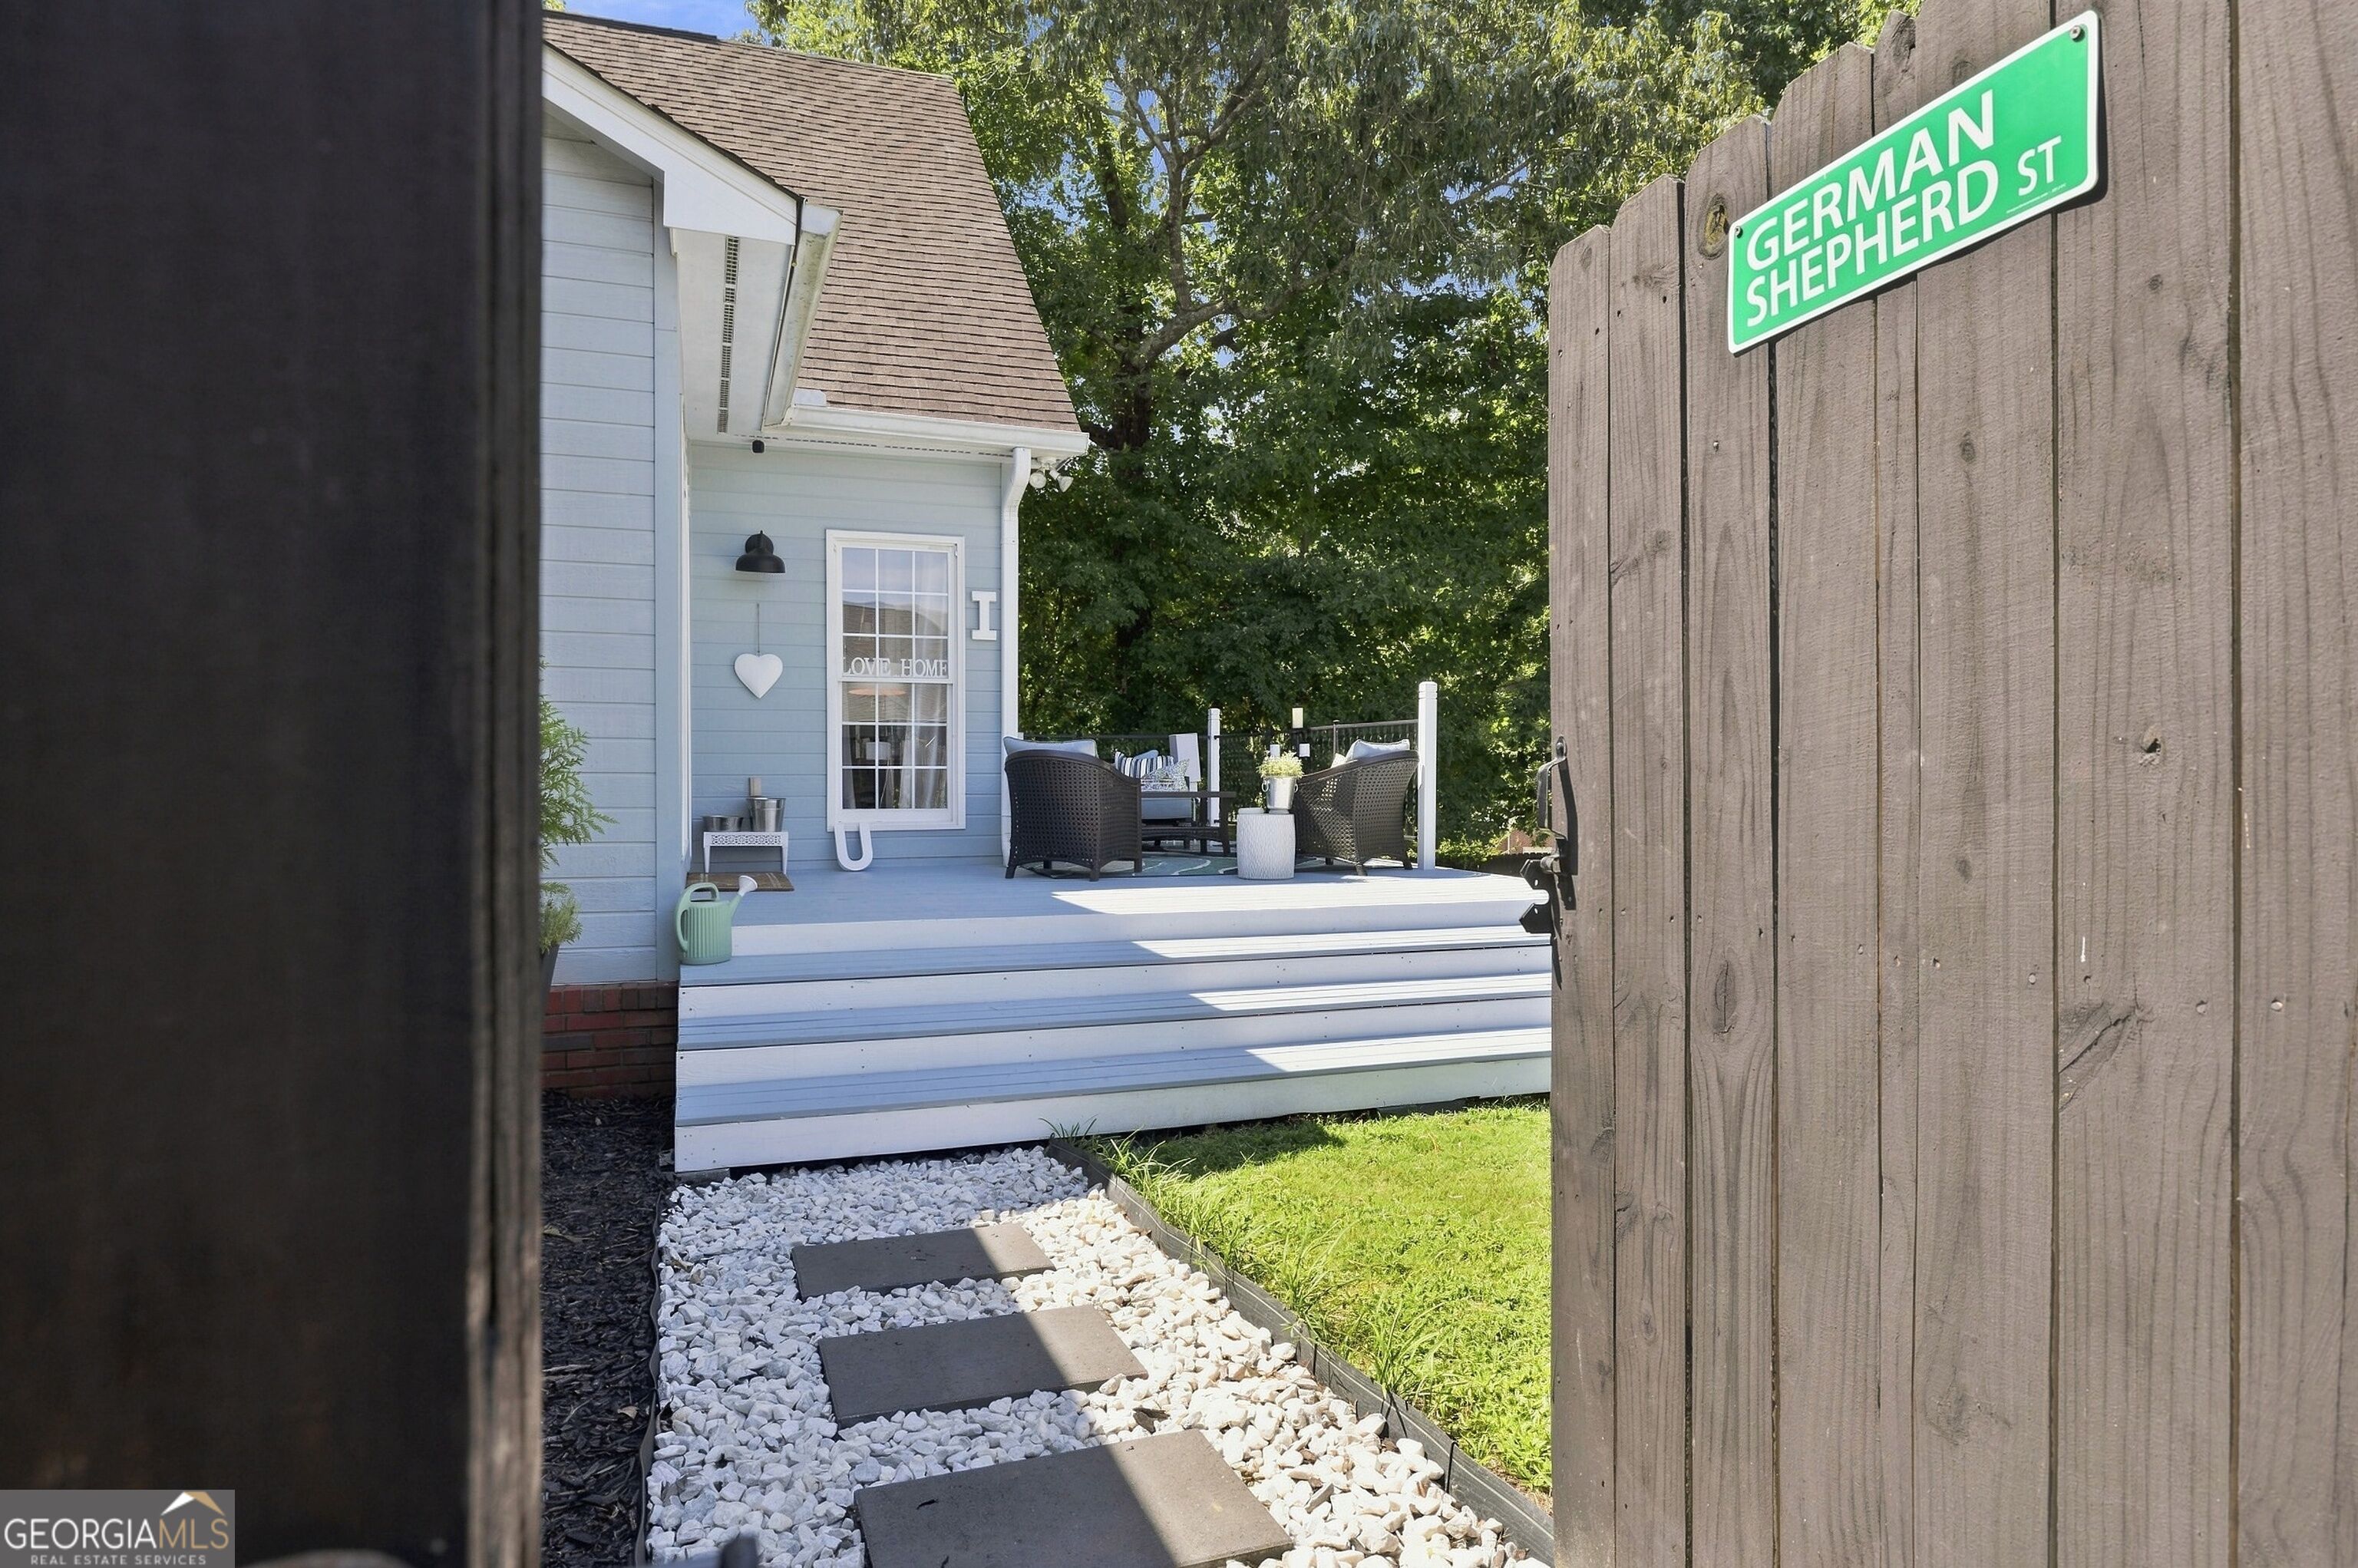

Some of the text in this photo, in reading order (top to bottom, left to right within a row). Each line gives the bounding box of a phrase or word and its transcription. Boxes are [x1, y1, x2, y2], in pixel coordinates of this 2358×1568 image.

[1746, 89, 1994, 271] GERMAN
[1746, 135, 2062, 328] SHEPHERD ST
[971, 590, 997, 641] I
